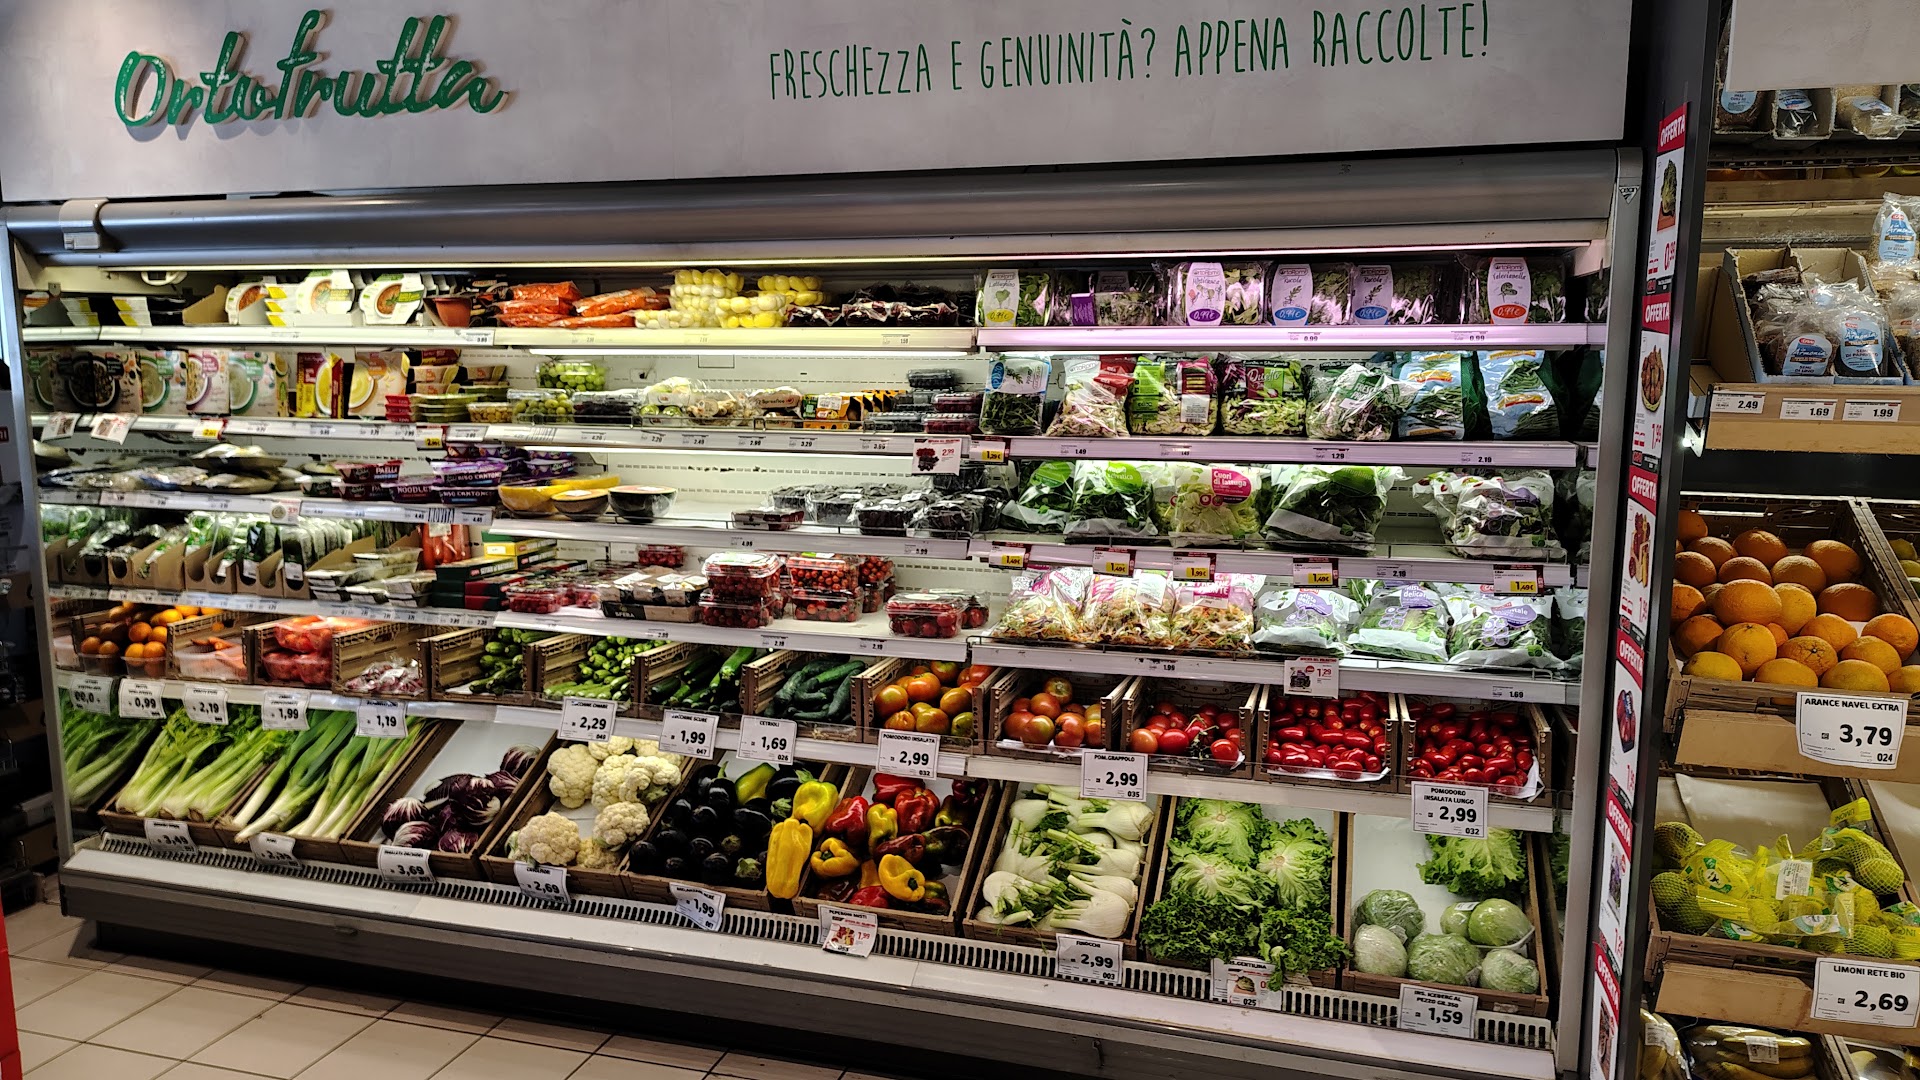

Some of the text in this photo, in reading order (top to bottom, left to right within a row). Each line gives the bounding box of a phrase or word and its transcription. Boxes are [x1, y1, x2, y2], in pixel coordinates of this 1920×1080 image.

[770, 0, 1489, 100] FRESCHEZZA E GENUINITÀ? APPENA RACCOLTE!
[115, 9, 508, 127] Ortofrutta
[1661, 114, 1685, 147] OFFERTA
[1645, 302, 1670, 323] OFFERTA
[1737, 400, 1759, 409] 2.49
[1809, 407, 1830, 416] 1.69
[1873, 408, 1894, 417] 1.99
[1213, 470, 1232, 480] Cuori
[1221, 479, 1247, 488] lattuga
[1631, 474, 1657, 501] OFFERTA
[1619, 639, 1644, 677] OFFERTA
[135, 697, 157, 710] 0,99
[199, 701, 220, 714] 2,19
[1804, 697, 1900, 712] ARANCE NAVEL EXTRA
[278, 708, 300, 720] 1,99
[376, 715, 397, 728] 1,19
[579, 716, 607, 731] 2,29
[759, 720, 780, 728] CETRIOLI
[680, 730, 706, 745] 1,99
[883, 733, 935, 744] POMODORO INSALATA
[1839, 723, 1892, 747] 3,79
[761, 736, 788, 751] 1,69
[777, 753, 789, 761] 026
[899, 750, 929, 766] 2,99
[1877, 752, 1893, 762] 024
[918, 769, 931, 777] 032
[1105, 771, 1138, 787] 2,99
[1127, 790, 1140, 798] 035
[1430, 787, 1466, 796] POMODORO
[1423, 795, 1475, 805] INSALATA LUNGO
[1439, 805, 1477, 823] 2,99
[1608, 800, 1632, 848] OFFERTA
[1465, 827, 1480, 835] 032
[397, 864, 425, 875] 3,69
[533, 880, 560, 894] 2,69
[693, 898, 716, 918] 1,99
[1080, 953, 1114, 969] 2,99
[1102, 971, 1115, 980] 003
[1833, 965, 1906, 980] LIMONI RETE BIO
[1597, 954, 1620, 1012] OFFERTA
[1243, 998, 1257, 1006] 025
[1416, 996, 1436, 1004] PEZZO
[1854, 989, 1909, 1012] 2,69
[1428, 1006, 1464, 1024] 1,59
